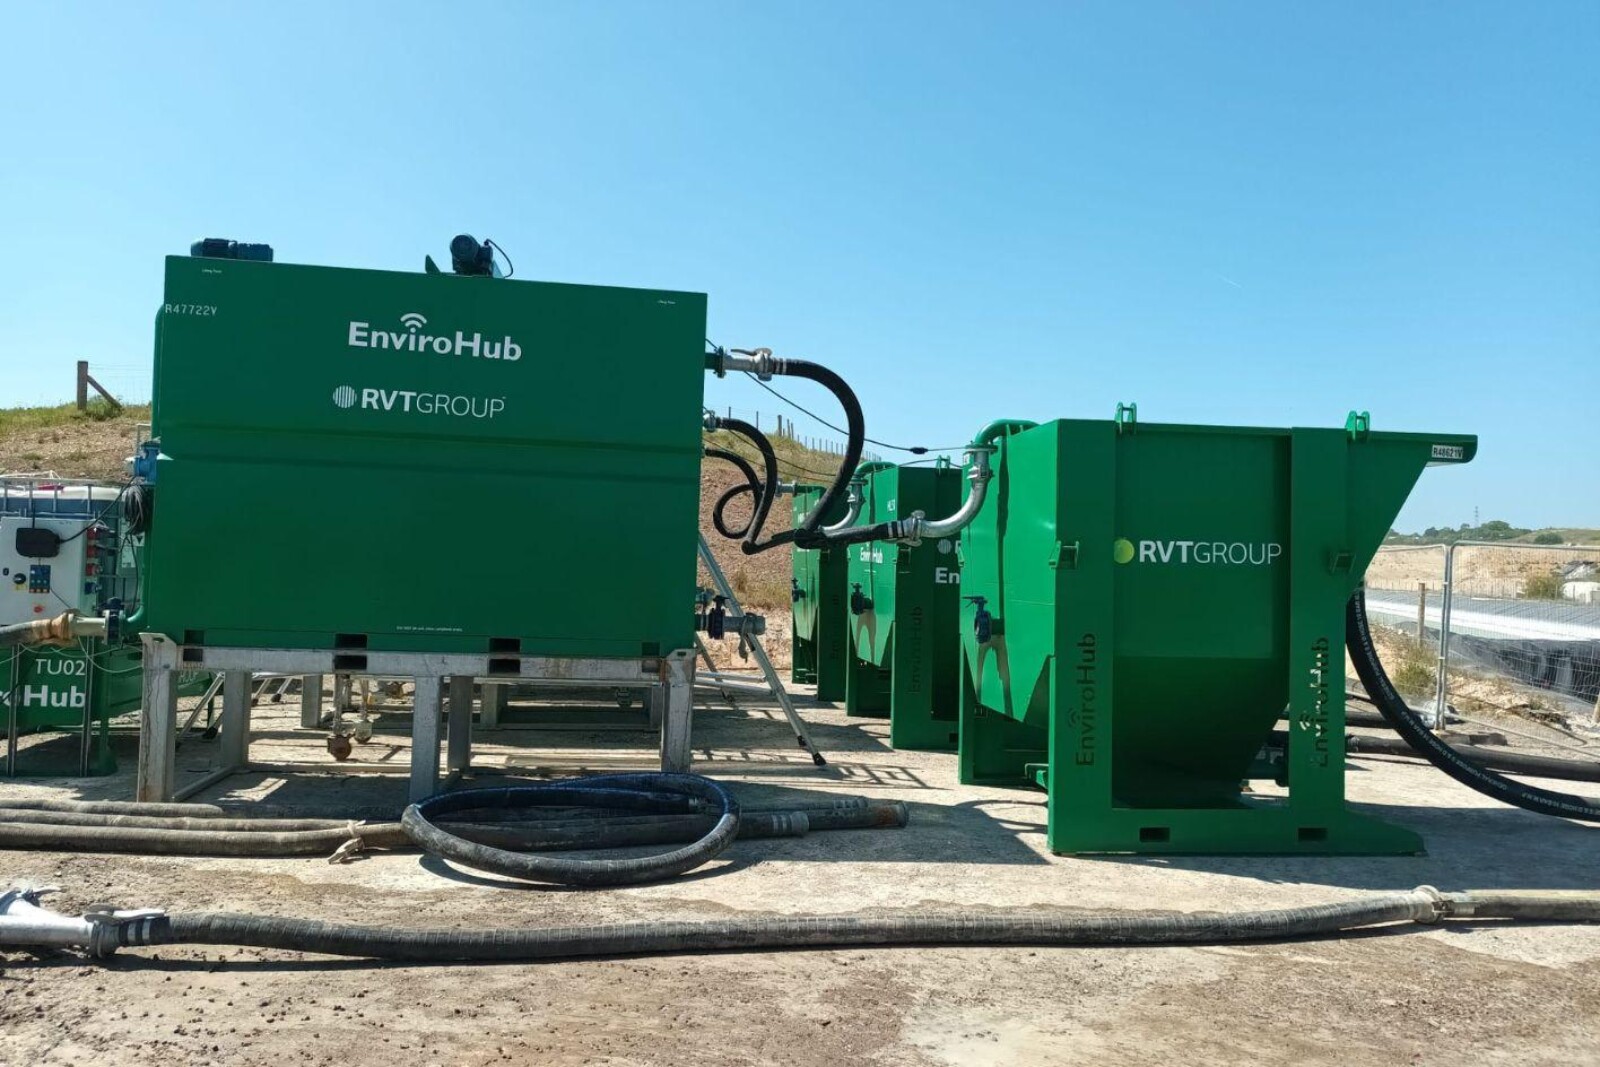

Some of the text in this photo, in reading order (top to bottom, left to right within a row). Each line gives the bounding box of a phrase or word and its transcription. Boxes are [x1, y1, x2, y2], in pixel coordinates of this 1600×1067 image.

[165, 303, 217, 316] R47722V
[348, 321, 522, 361] EnviroHub
[361, 388, 505, 418] RVTGROUP
[1139, 540, 1282, 564] RVTGROUP
[36, 659, 86, 676] TU02
[1075, 633, 1096, 766] EnviroHub
